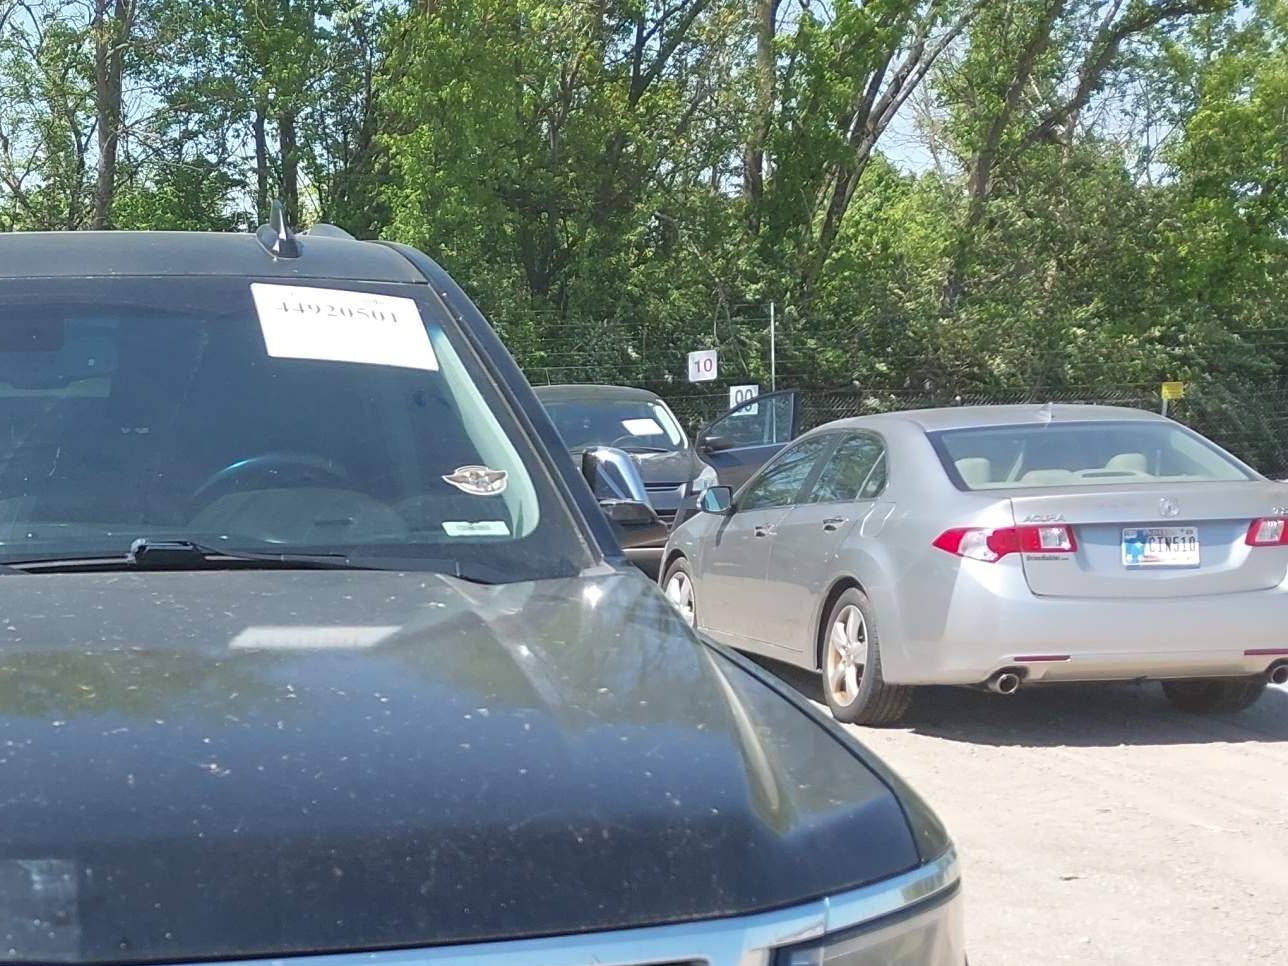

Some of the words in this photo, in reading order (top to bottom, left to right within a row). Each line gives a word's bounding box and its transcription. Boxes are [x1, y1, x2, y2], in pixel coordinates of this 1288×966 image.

[275, 301, 398, 323] 44920501
[694, 358, 713, 373] 10
[1023, 512, 1065, 522] ACURA
